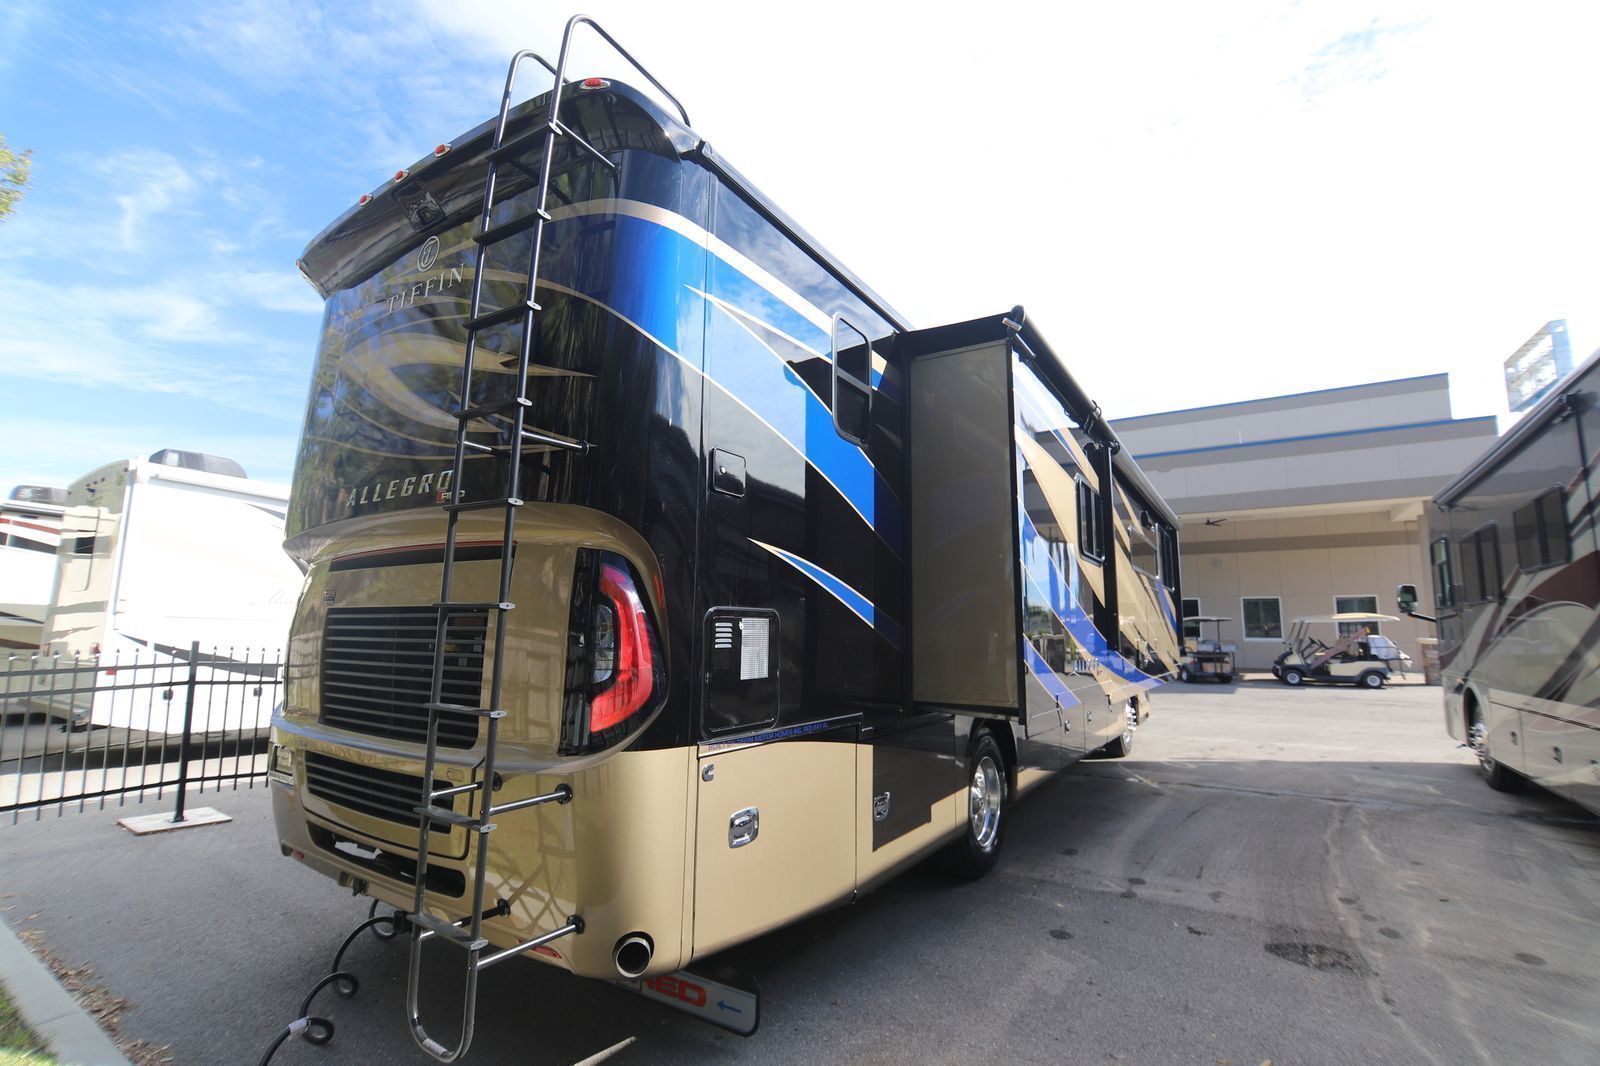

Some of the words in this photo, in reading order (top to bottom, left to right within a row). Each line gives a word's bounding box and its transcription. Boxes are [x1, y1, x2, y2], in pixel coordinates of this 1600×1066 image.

[384, 262, 466, 313] TIFFIN
[345, 469, 454, 507] ALLEGRO
[755, 732, 774, 743] MOTOR
[774, 728, 793, 739] HOMES
